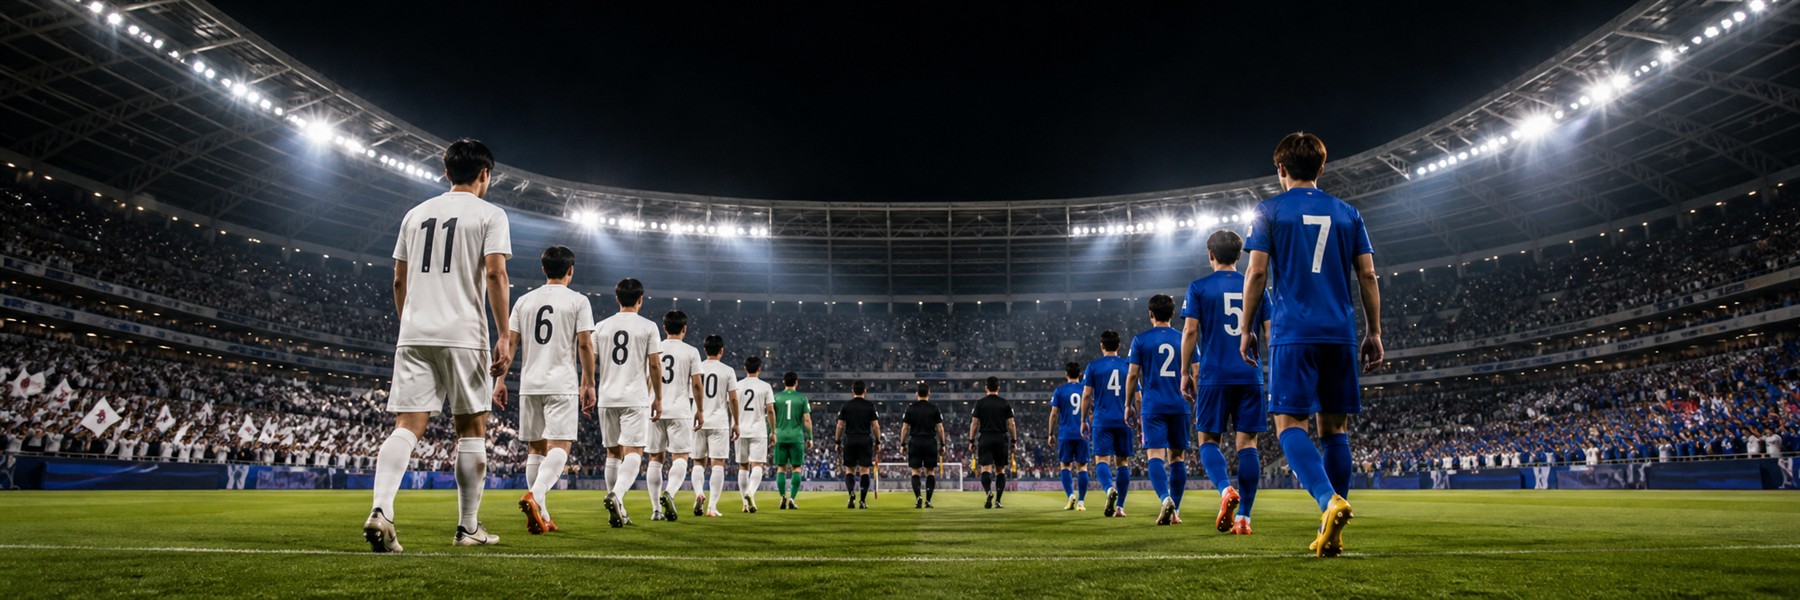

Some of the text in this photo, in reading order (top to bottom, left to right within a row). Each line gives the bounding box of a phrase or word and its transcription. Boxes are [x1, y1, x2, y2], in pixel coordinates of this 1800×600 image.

[421, 217, 458, 274] 11
[1302, 215, 1332, 274] 7
[534, 304, 554, 345] 6
[1223, 292, 1243, 336] 5
[611, 330, 629, 366] 8
[1158, 343, 1176, 377] 2
[661, 354, 675, 385] 3
[1107, 369, 1122, 397] 4
[743, 388, 755, 412] 2
[785, 399, 792, 420] 1
[1069, 393, 1083, 416] 9
